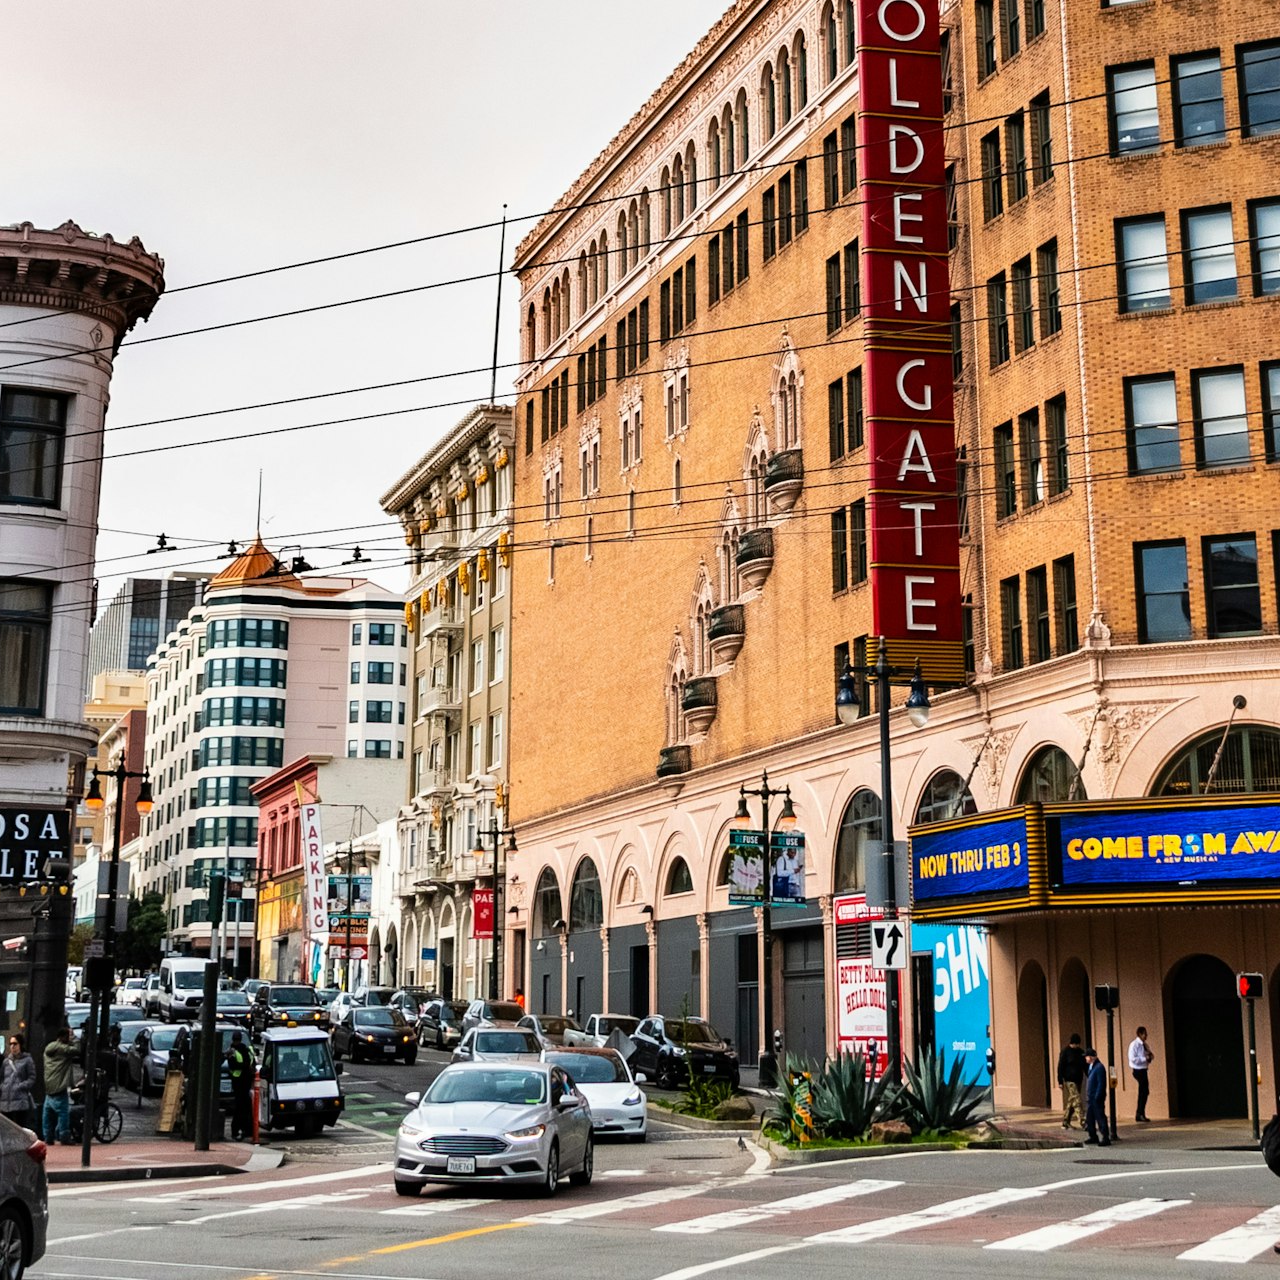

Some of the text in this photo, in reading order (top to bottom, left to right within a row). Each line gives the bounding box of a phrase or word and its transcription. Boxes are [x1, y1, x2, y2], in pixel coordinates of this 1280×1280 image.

[896, 359, 937, 632] GATE
[734, 835, 759, 844] REFUSE
[778, 838, 799, 846] REUSE
[1067, 836, 1144, 861] COME
[306, 807, 324, 927] PARKING
[920, 841, 1022, 879] NOW THRU FEB 3
[1184, 855, 1218, 863] MUSICAL
[840, 965, 863, 984] BETTY
